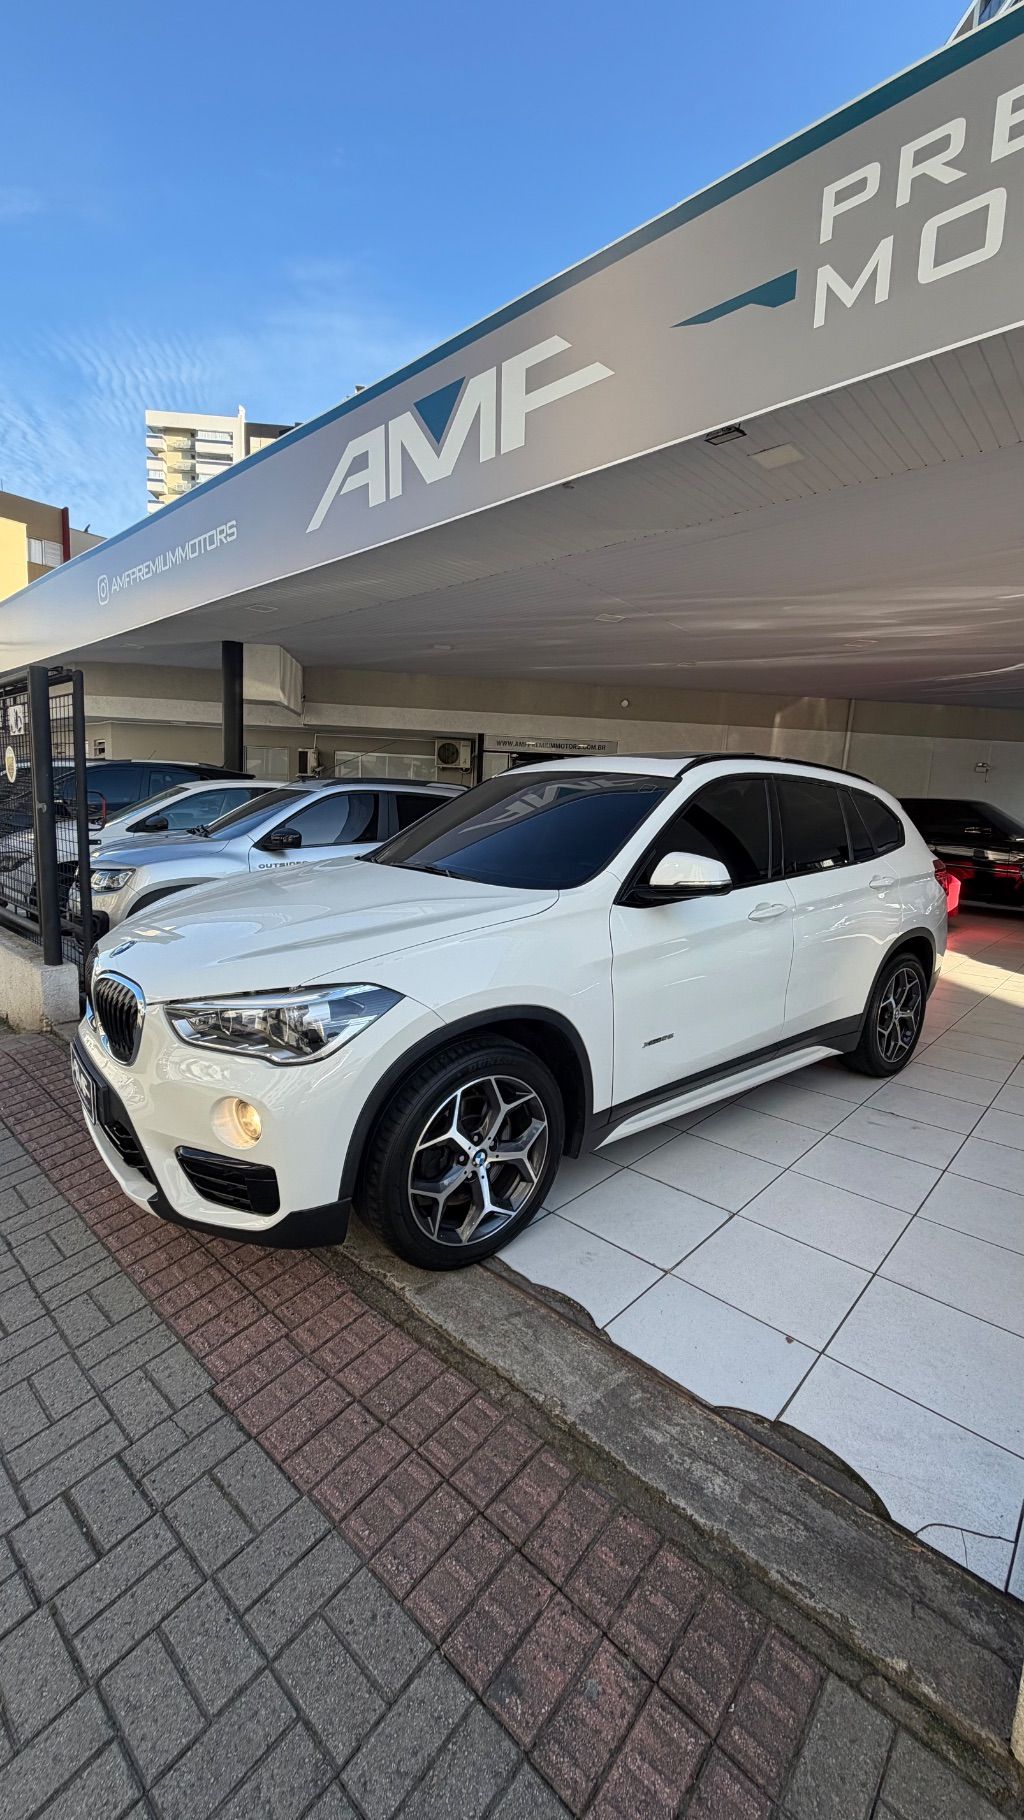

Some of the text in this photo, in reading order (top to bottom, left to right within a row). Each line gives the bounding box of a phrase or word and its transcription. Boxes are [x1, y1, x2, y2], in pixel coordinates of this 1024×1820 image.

[814, 187, 1008, 329] MO
[305, 334, 616, 534] AMF
[111, 520, 238, 594] AMFPREMIUMMOTORS
